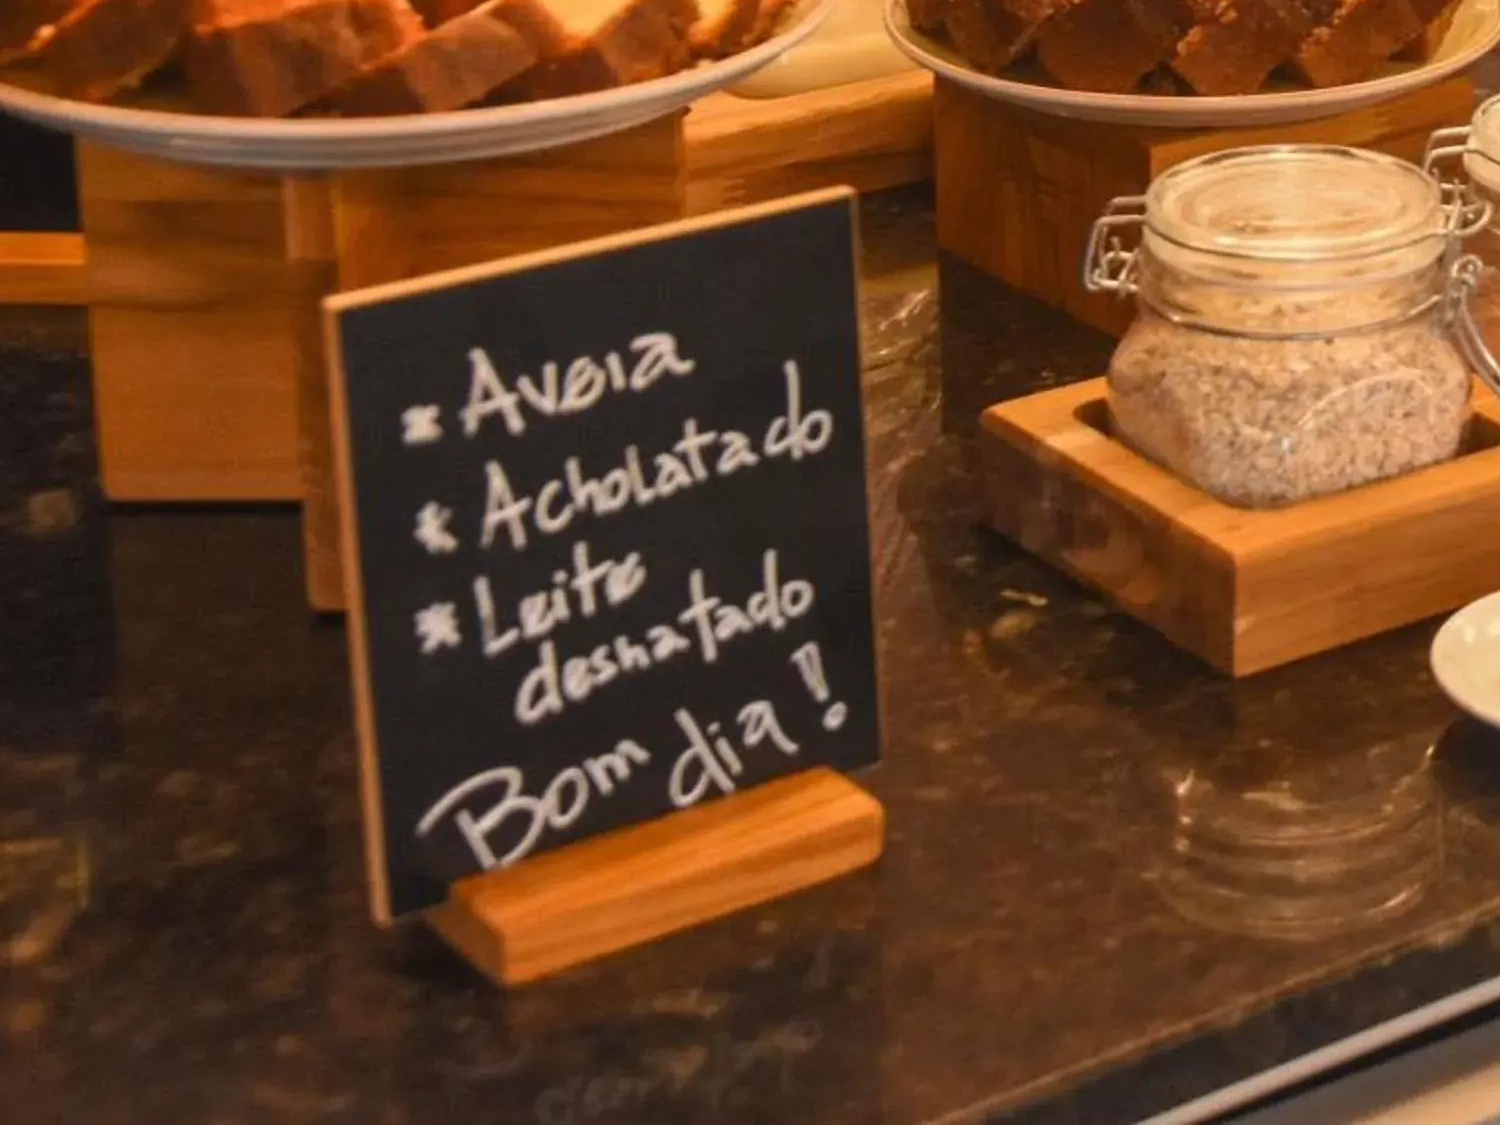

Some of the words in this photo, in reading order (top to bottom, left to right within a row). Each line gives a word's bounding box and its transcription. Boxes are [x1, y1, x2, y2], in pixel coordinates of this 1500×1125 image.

[459, 331, 695, 436] Aveia
[477, 360, 834, 551] Acholatado
[473, 539, 647, 658] Leite
[513, 548, 815, 724] desnatado
[416, 735, 652, 872] Bom
